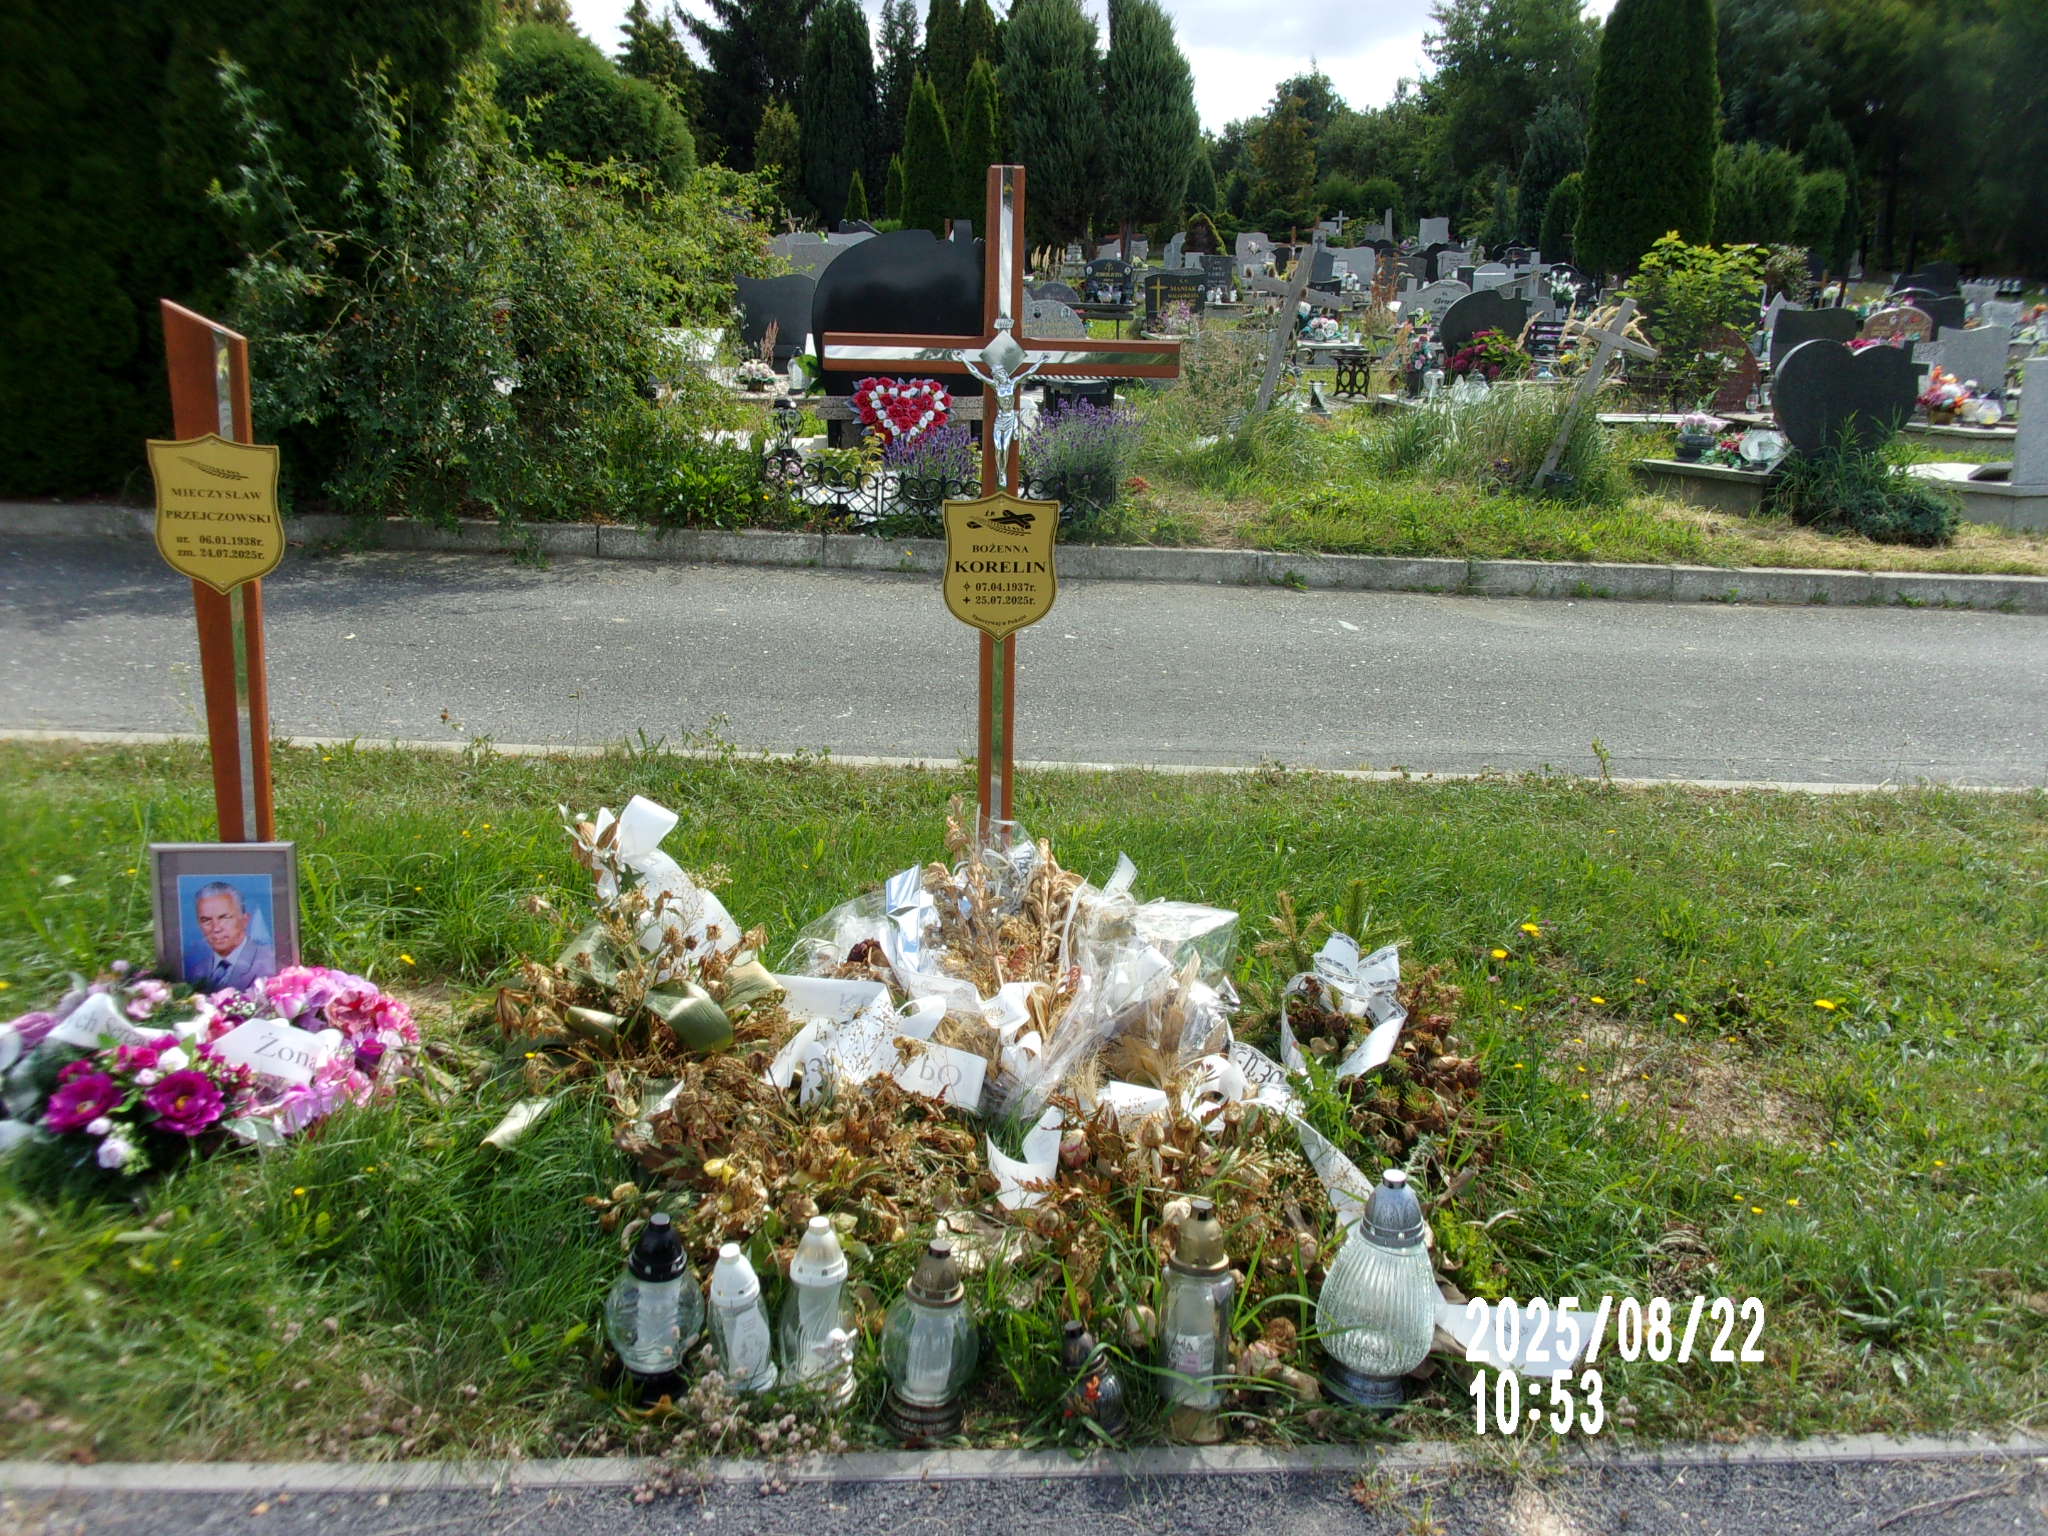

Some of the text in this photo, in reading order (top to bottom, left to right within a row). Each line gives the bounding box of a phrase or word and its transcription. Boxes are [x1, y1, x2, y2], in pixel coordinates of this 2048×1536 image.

[171, 487, 262, 500] MIECZYSŁAW
[165, 510, 272, 524] PRZEJCZOWSKI
[972, 543, 1029, 554] BOŻENNA
[955, 560, 1046, 574] KORELIN
[975, 582, 1036, 592] 07.04.1937r.
[975, 595, 1036, 605] 25.07.2025r.
